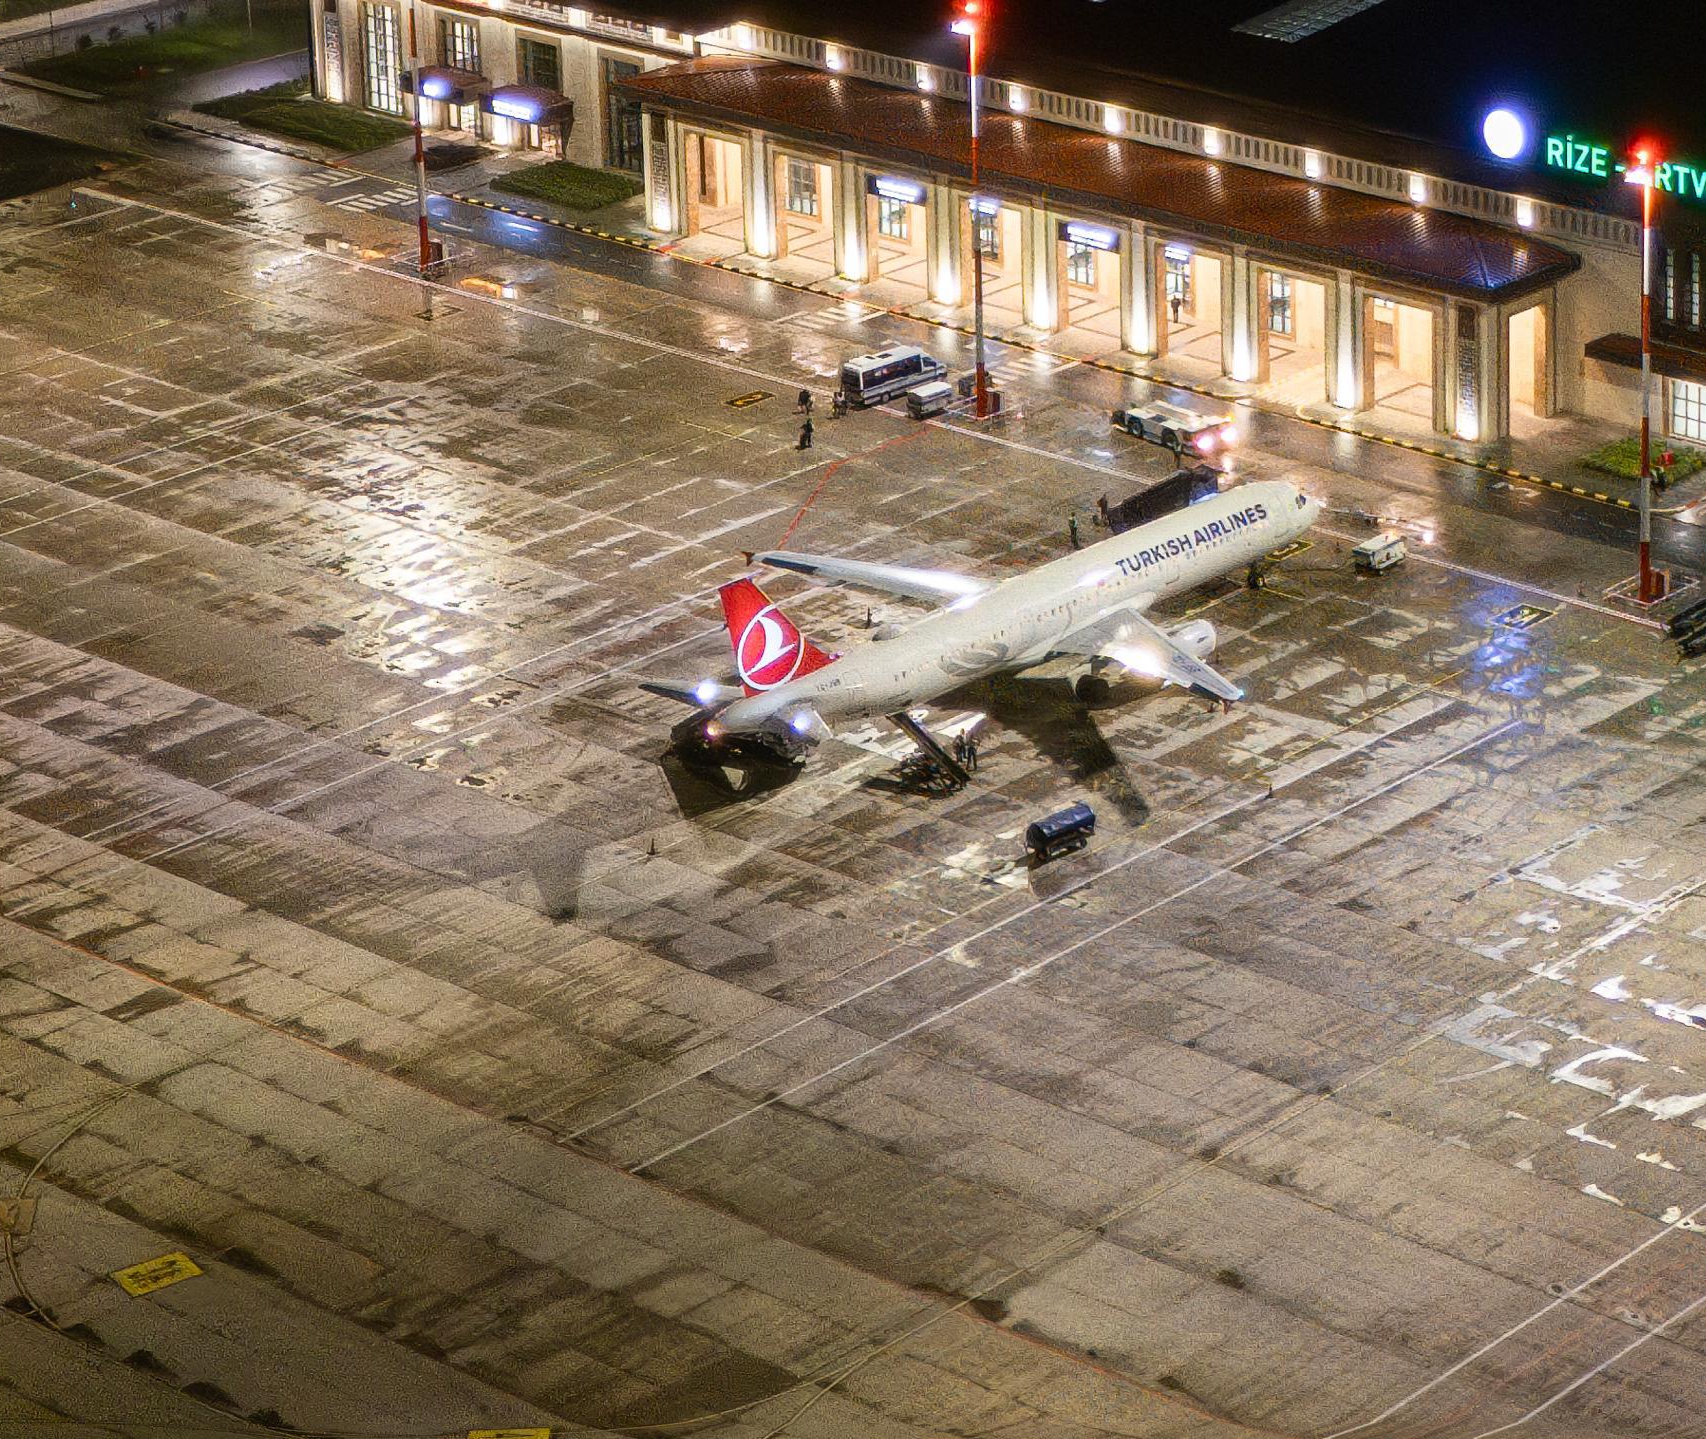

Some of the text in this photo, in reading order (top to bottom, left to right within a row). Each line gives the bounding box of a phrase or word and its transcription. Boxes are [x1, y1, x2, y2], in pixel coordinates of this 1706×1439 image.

[1546, 134, 1608, 178] RİZE
[1115, 503, 1268, 576] TURKISH AIRLINES
